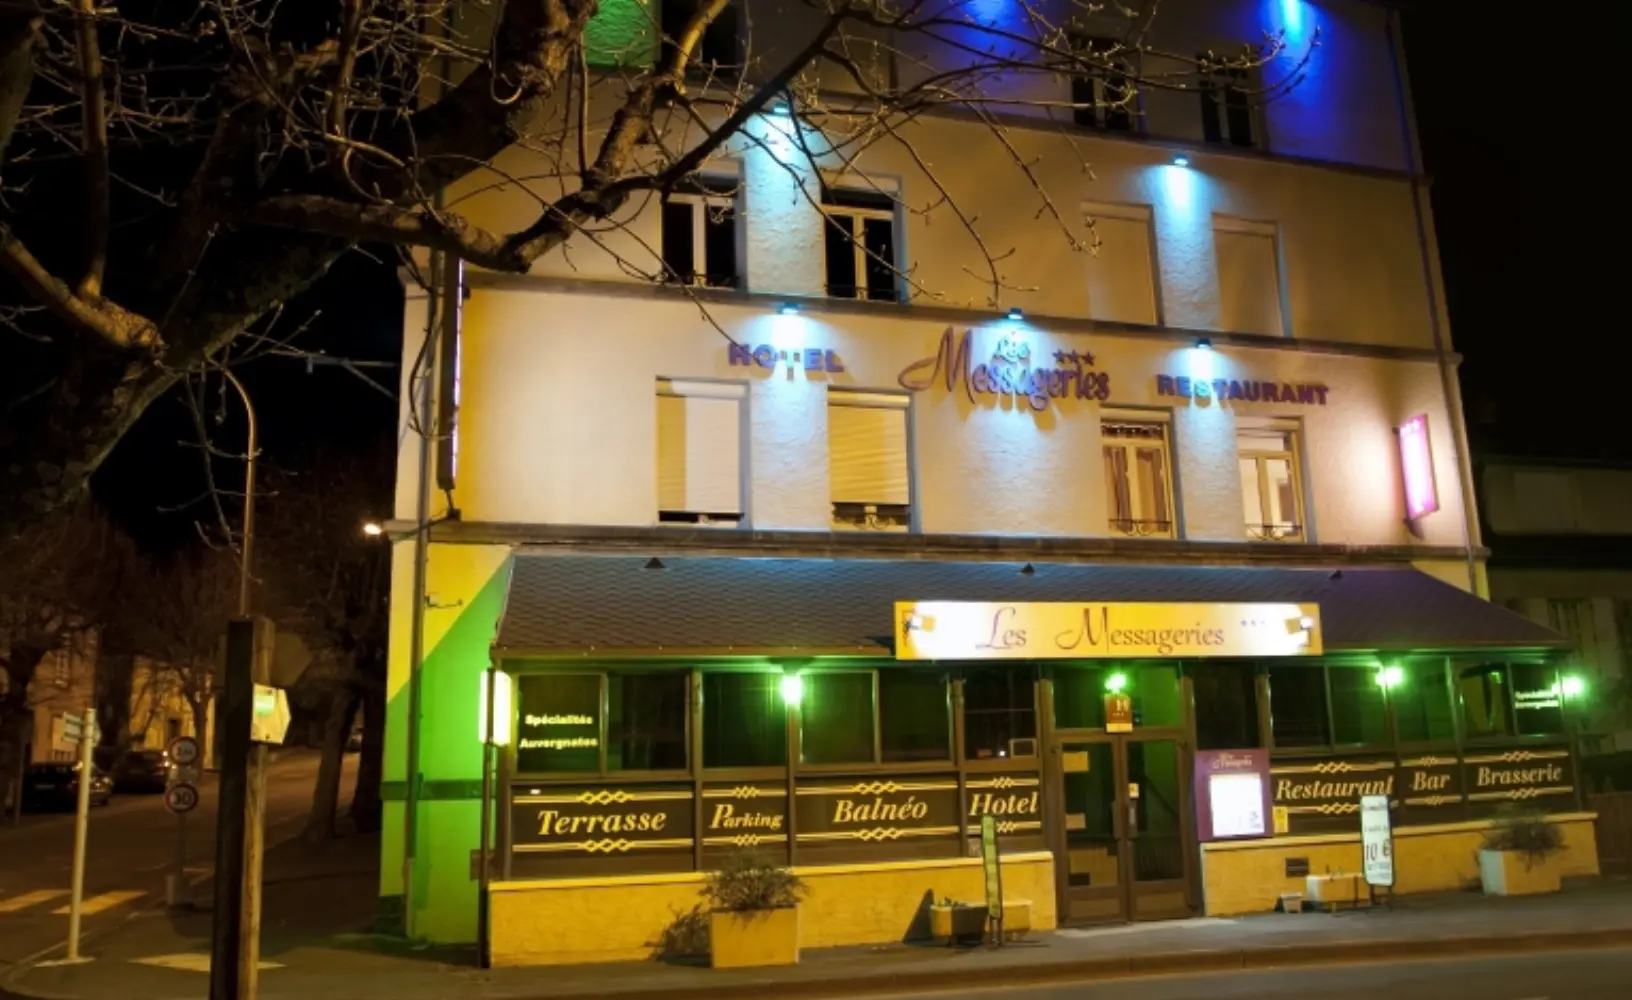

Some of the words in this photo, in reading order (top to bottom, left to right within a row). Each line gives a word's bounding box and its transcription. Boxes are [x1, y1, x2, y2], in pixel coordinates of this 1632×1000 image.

[897, 324, 1110, 411] Messageries
[1156, 374, 1330, 405] RESTAURANT
[974, 607, 1028, 650] Les
[1055, 606, 1225, 656] Messageries
[1275, 774, 1395, 801] Restaurant
[1412, 770, 1451, 792] Bar
[1476, 763, 1563, 787] Brasserie
[708, 802, 784, 831] Parking
[832, 795, 929, 825] Balnéo
[968, 790, 1040, 817] Hotel
[537, 808, 667, 836] Terrasse
